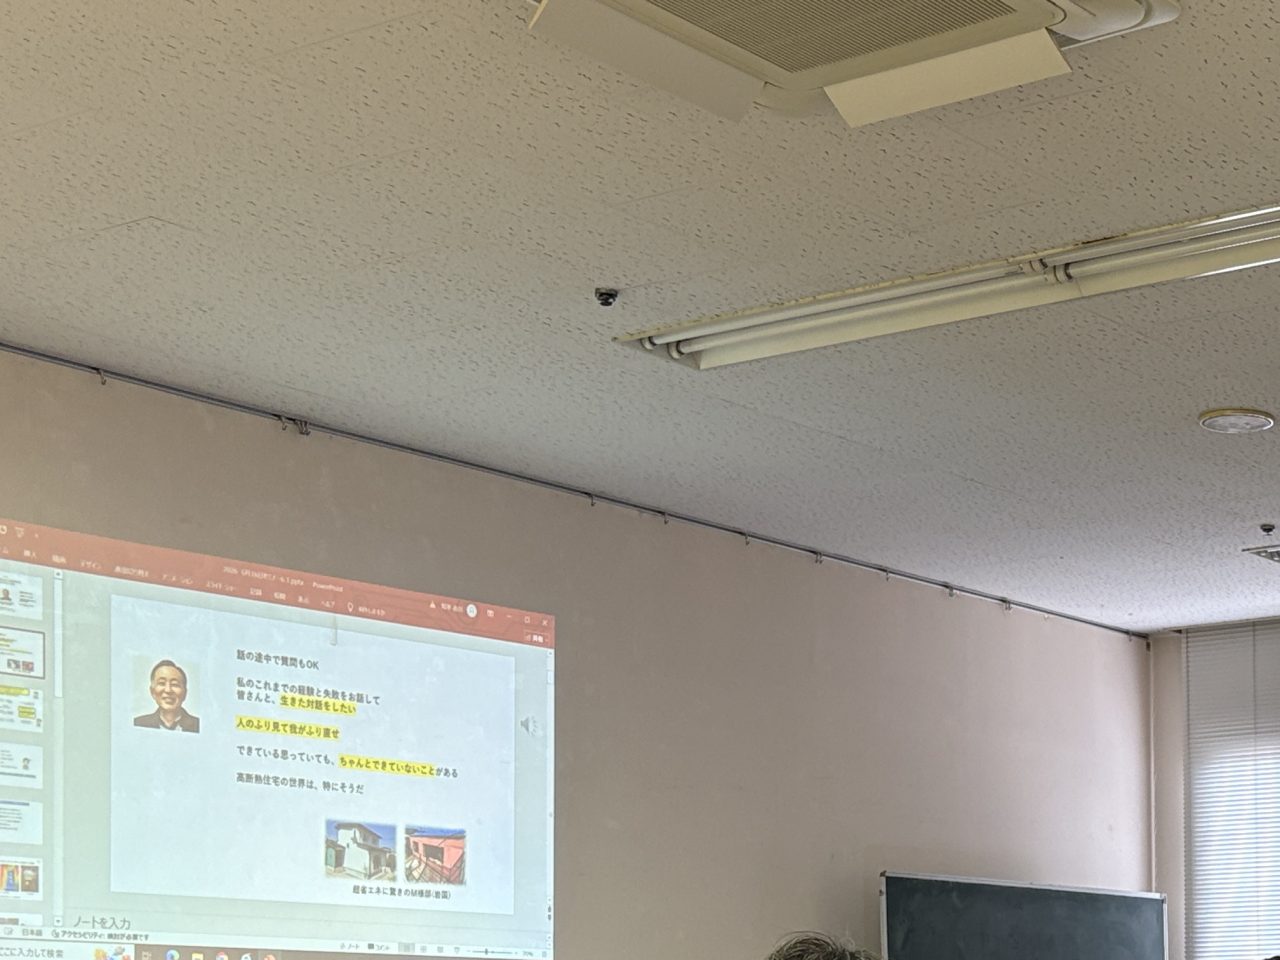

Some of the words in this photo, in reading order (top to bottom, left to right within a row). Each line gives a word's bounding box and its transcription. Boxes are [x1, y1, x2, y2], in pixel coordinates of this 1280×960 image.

[236, 649, 320, 671] 話の途中で質問もOK
[236, 717, 340, 740] 人のふり見て我がふり直せ
[73, 914, 132, 931] ノートを入力
